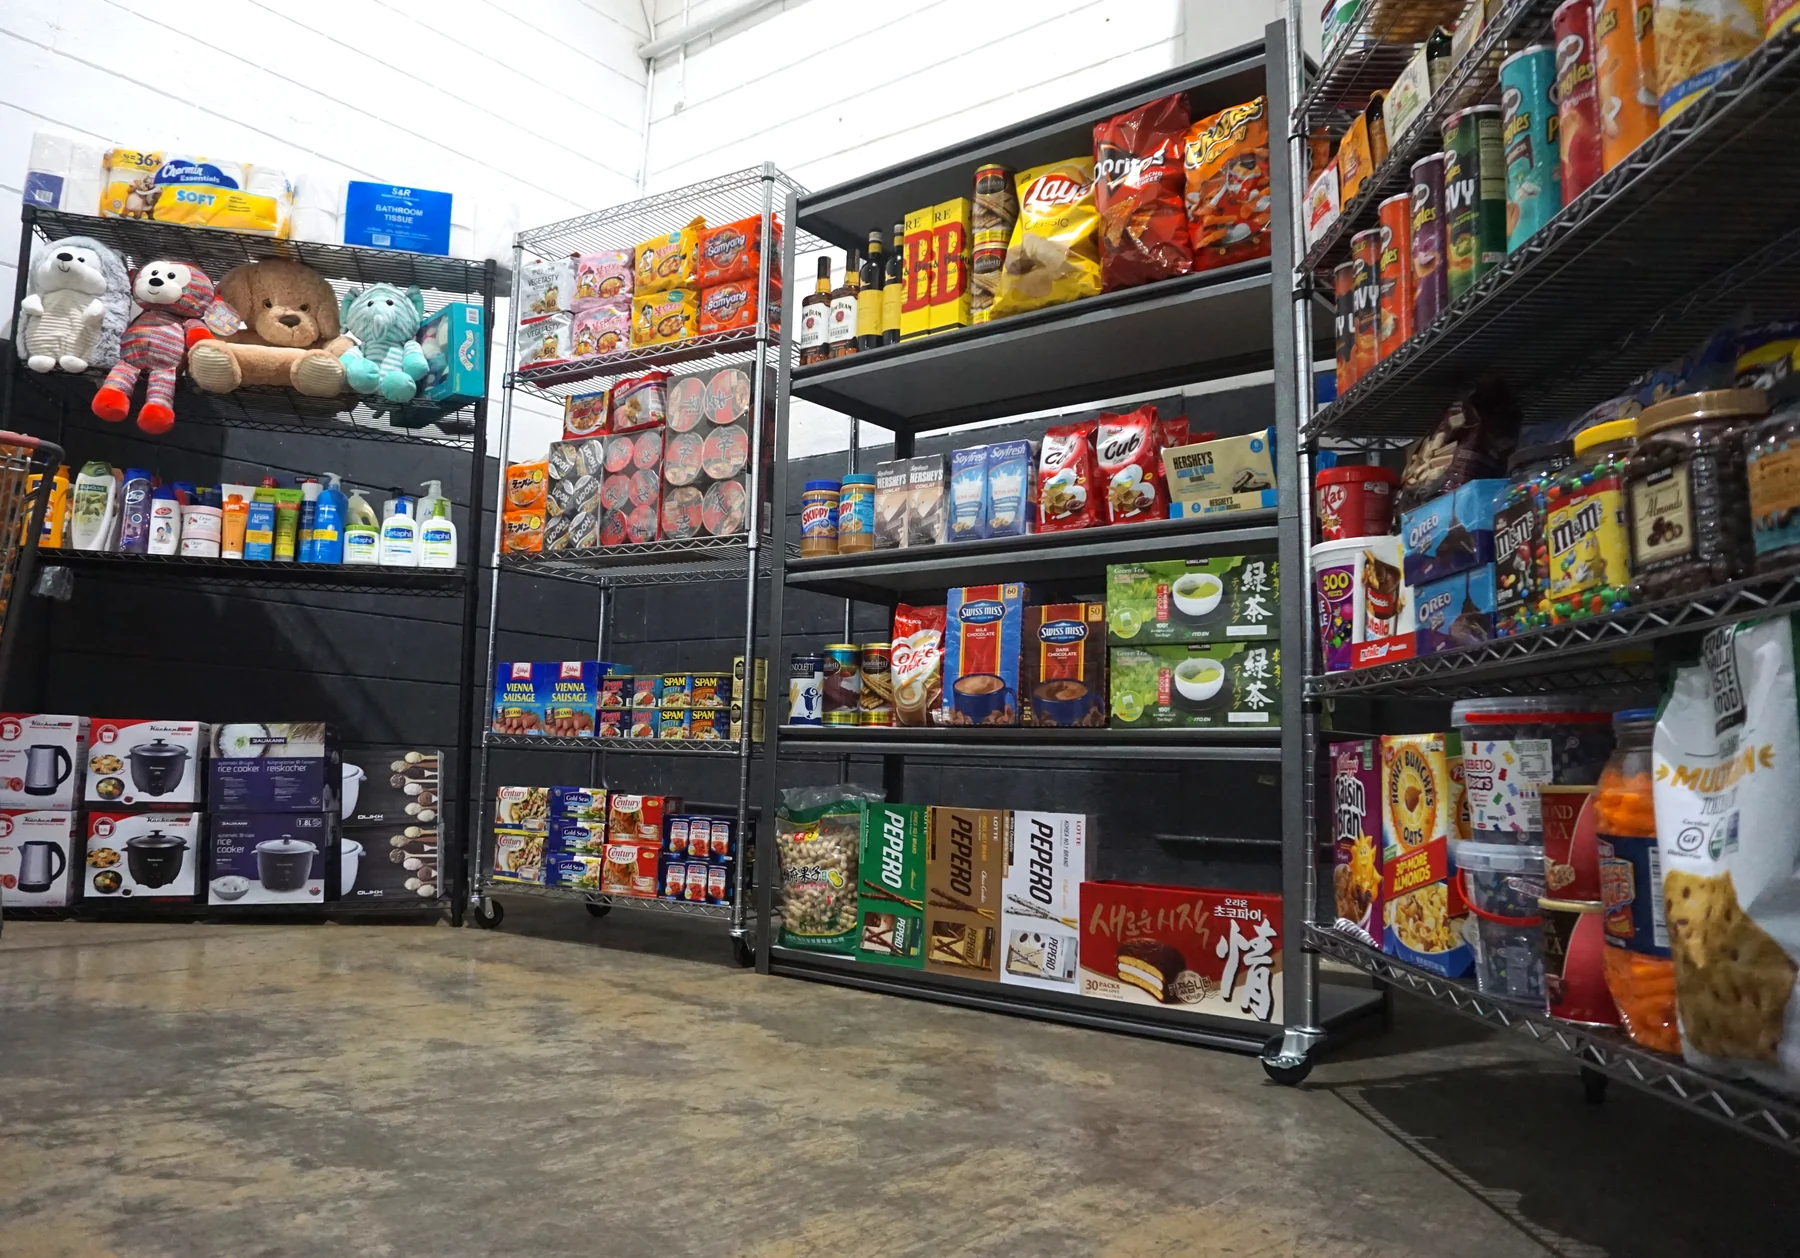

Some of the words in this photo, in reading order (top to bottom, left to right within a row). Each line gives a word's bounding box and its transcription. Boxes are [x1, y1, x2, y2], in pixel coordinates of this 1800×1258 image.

[162, 164, 203, 178] Charmin
[180, 174, 220, 183] Essentials
[176, 190, 215, 205] SOFT
[391, 188, 411, 196] S&R
[376, 205, 423, 216] BATHROOM
[384, 214, 414, 224] TISSUE
[707, 234, 746, 257] Samyang
[528, 275, 559, 287] VEGETASTY
[707, 290, 747, 311] Samyang
[839, 302, 852, 311] BEAM
[583, 444, 598, 468] UDON
[952, 451, 987, 465] Soyfresh
[989, 444, 1026, 459] Soyfresh
[1172, 451, 1213, 470] HERSHEY'S
[512, 478, 533, 488] ラーメン
[877, 473, 906, 489] HERSHEY'S
[910, 469, 944, 483] HERSHEY'S
[575, 480, 594, 505] UDON
[1209, 497, 1234, 507] HERSHEY'S
[1638, 489, 1683, 522] Almonds
[801, 507, 829, 525] SKIPPY
[385, 530, 412, 539] Cetaphil
[507, 522, 530, 533] ラーメン
[546, 521, 566, 544] UDON
[573, 519, 592, 544] UDON
[1408, 513, 1439, 548] OREO
[349, 537, 373, 545] Cetaphil
[423, 530, 450, 540] Cetaphil
[1323, 575, 1349, 591] 300
[1007, 587, 1016, 595] 60
[1241, 561, 1273, 623] 緑茶
[1230, 577, 1240, 624] ティーバッグ
[1418, 592, 1451, 623] OREO
[961, 607, 983, 619] SWISS
[984, 605, 1003, 616] MISS
[1090, 607, 1100, 615] 50
[1041, 627, 1064, 638] SWISS
[1065, 626, 1084, 636] MISS
[664, 677, 685, 686] SPAM
[695, 677, 717, 687] SPAM
[1242, 647, 1275, 710] 緑茶
[506, 683, 534, 692] VIENNA
[555, 682, 585, 692] VIENNA
[1232, 664, 1242, 710] ティーバッグ
[502, 693, 536, 702] SAUSAGE
[551, 692, 587, 702] SAUSAGE
[662, 711, 684, 720] SPAM
[692, 711, 715, 720] SPAM
[217, 765, 231, 773] rice
[233, 765, 259, 773] cooker
[267, 764, 307, 772] reiskocher
[1391, 756, 1404, 804] HONEY
[1405, 750, 1434, 808] BUNCHES
[501, 788, 526, 800] Century
[1335, 775, 1365, 816] Raisin
[613, 796, 640, 809] Century
[1337, 809, 1360, 840] Bran
[498, 835, 522, 848] Century
[1063, 838, 1068, 846] NO
[1403, 826, 1423, 846] OATS
[1682, 834, 1699, 844] GF
[216, 845, 245, 853] cooker
[608, 846, 636, 859] Century
[881, 809, 905, 889] PEPERO
[950, 814, 973, 897] PEPERO
[1029, 818, 1053, 905] PEPERO
[1408, 852, 1429, 871] MORE
[1393, 866, 1431, 892] ALMONDS
[1224, 897, 1248, 908] 오리온
[1213, 905, 1262, 922] 초코파이
[1088, 903, 1154, 942] 새로운
[1157, 900, 1210, 949] 시작
[895, 917, 906, 949] PEPERO
[965, 927, 977, 959] PEPERO
[1045, 936, 1058, 971] PEPERO
[1215, 917, 1278, 1022] 情
[1085, 979, 1099, 991] 30
[1099, 981, 1120, 990] PACKS
